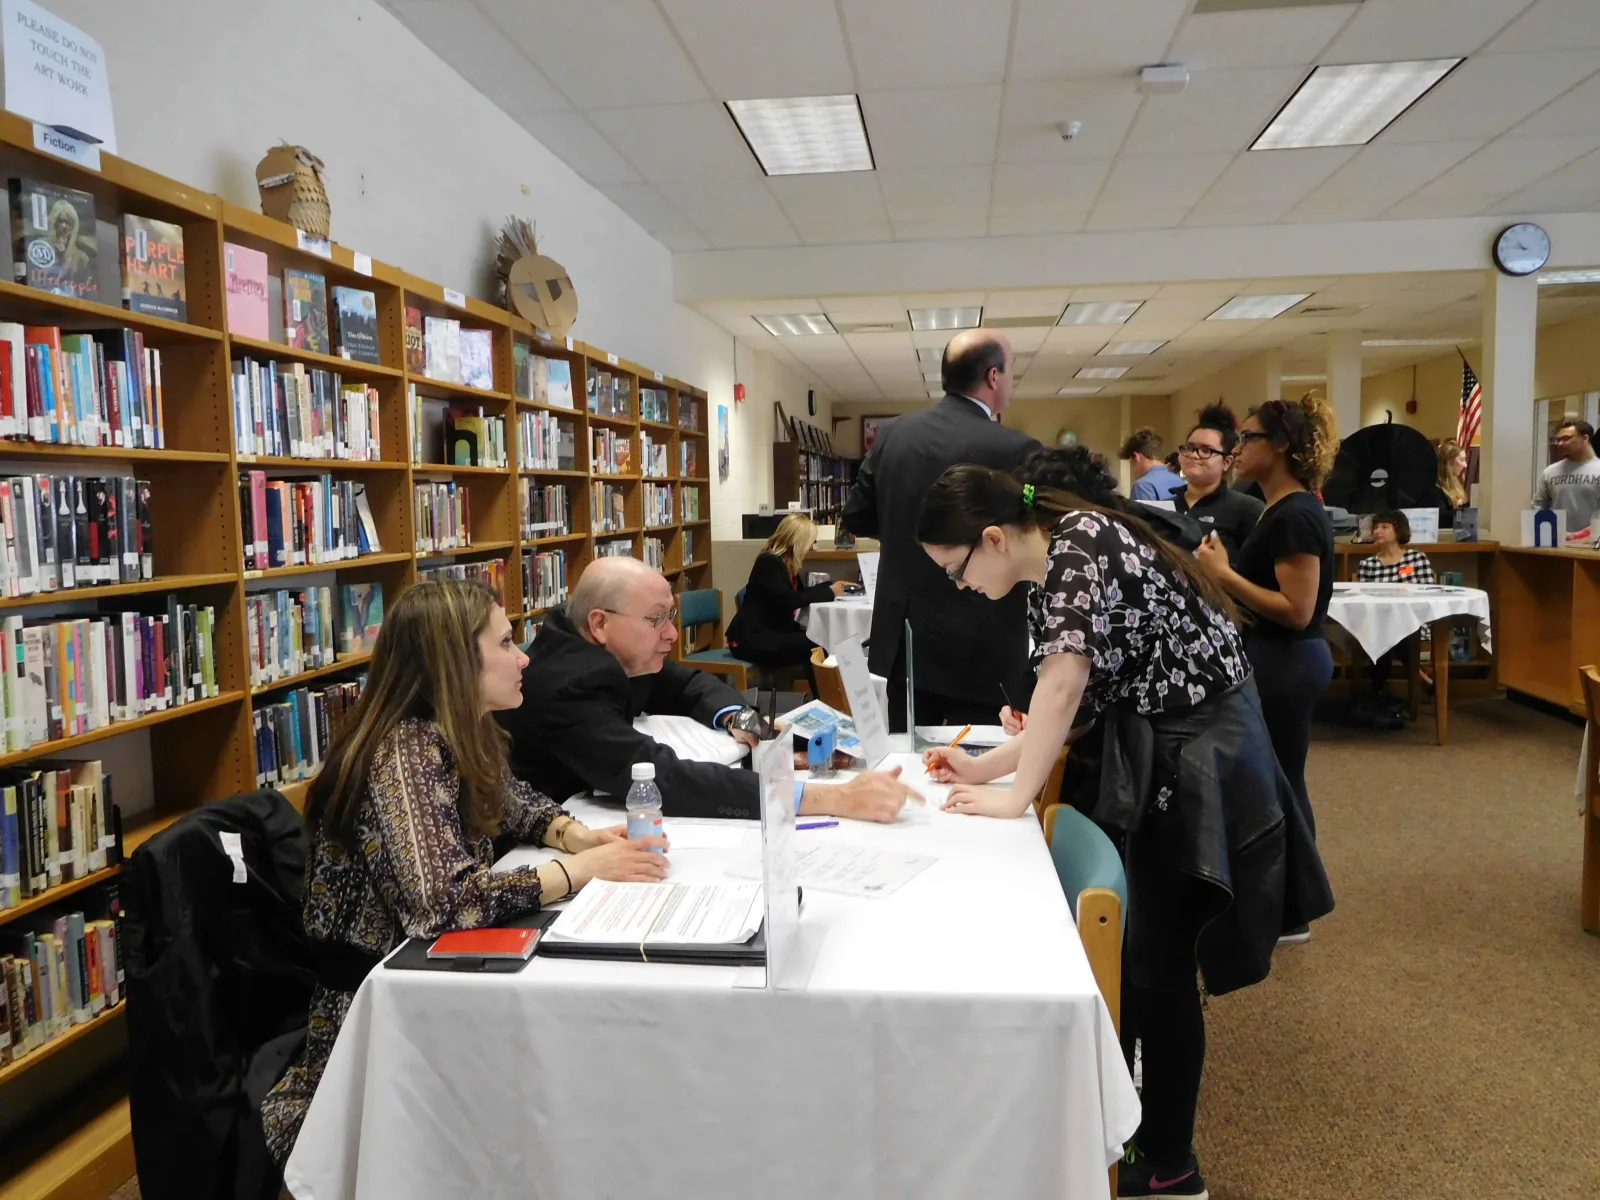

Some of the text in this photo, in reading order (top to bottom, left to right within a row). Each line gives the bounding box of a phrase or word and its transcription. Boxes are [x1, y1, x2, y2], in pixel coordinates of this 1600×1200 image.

[17, 11, 97, 65] PLEASE DO NOT
[30, 38, 92, 80] TOUCH THE
[34, 62, 89, 97] ART WORK
[43, 132, 76, 154] Fiction
[125, 236, 185, 265] PRPLE
[127, 256, 178, 280] HEART
[1550, 473, 1600, 485] FORDHAM
